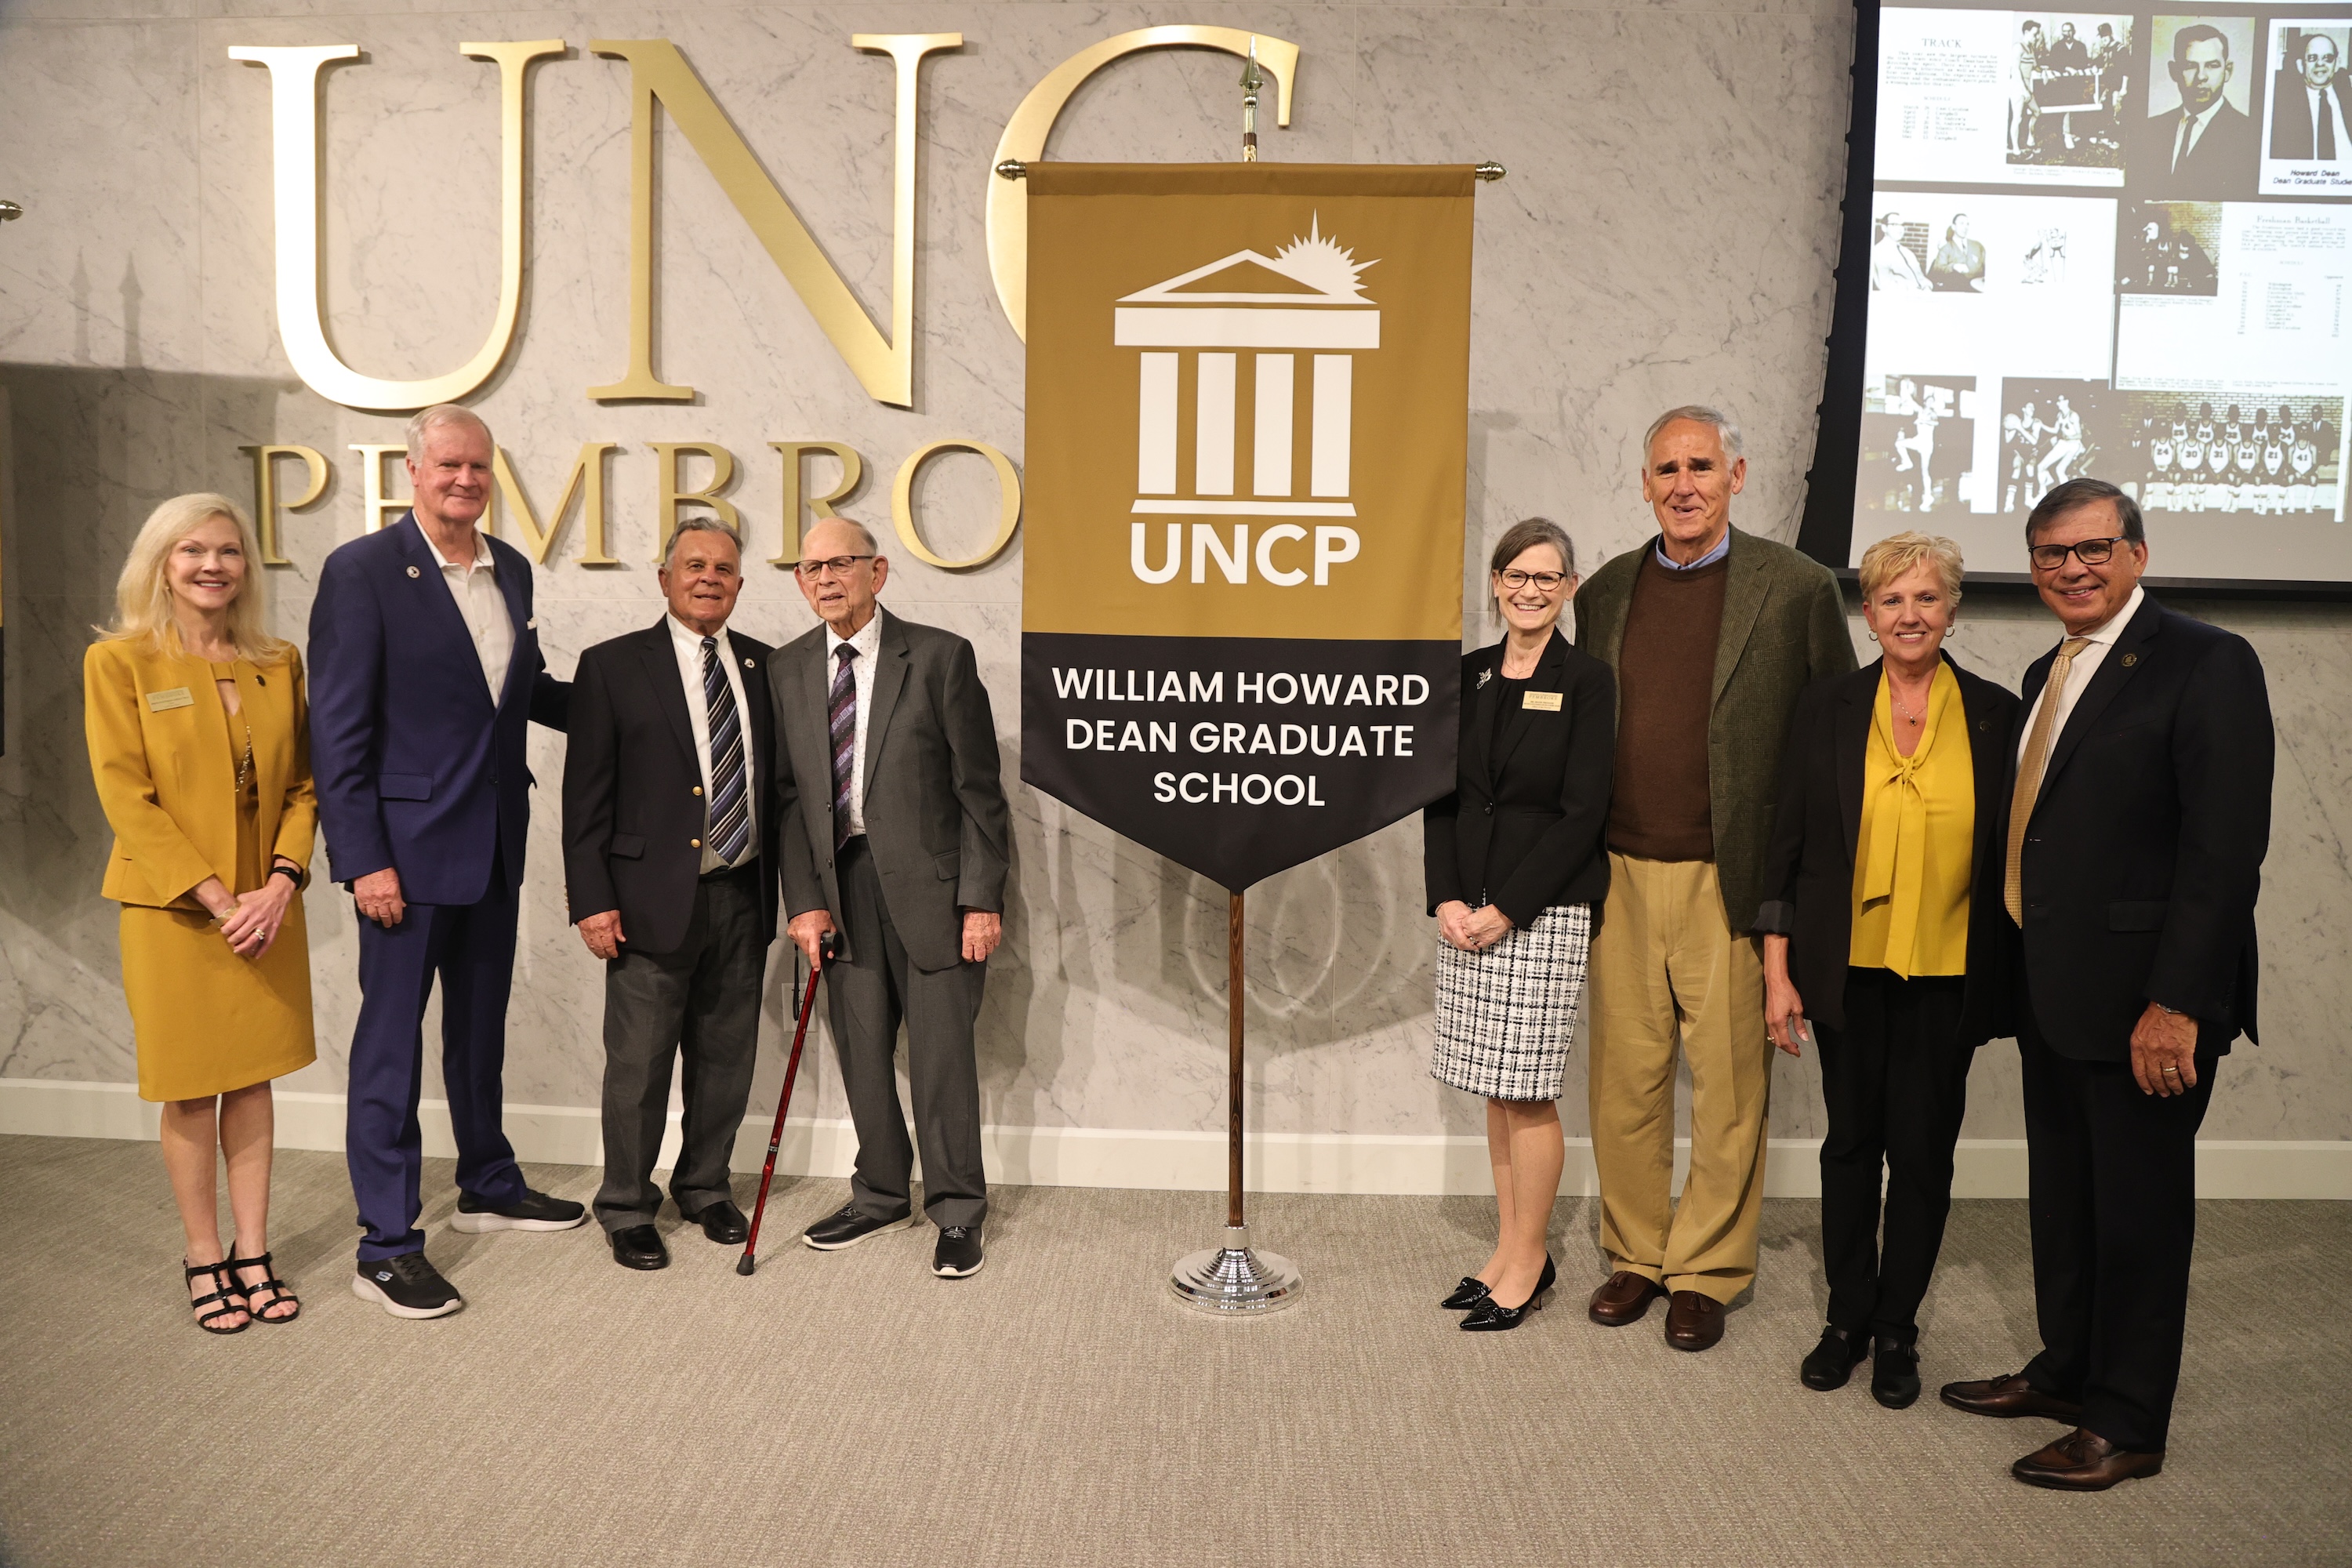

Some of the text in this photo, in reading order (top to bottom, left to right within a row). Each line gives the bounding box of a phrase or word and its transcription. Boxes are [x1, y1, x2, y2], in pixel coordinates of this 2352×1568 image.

[1922, 38, 1962, 48] TRACK
[228, 24, 1299, 410] UNC
[2257, 215, 2330, 224] Freshman Basketball
[238, 439, 1022, 568] PEMBRO
[1130, 522, 1361, 586] UNCP
[1051, 667, 1430, 706] WILLIAM HOWARD
[1066, 718, 1414, 757] DEAN GRADUATE
[1153, 771, 1325, 807] SCHOOL
